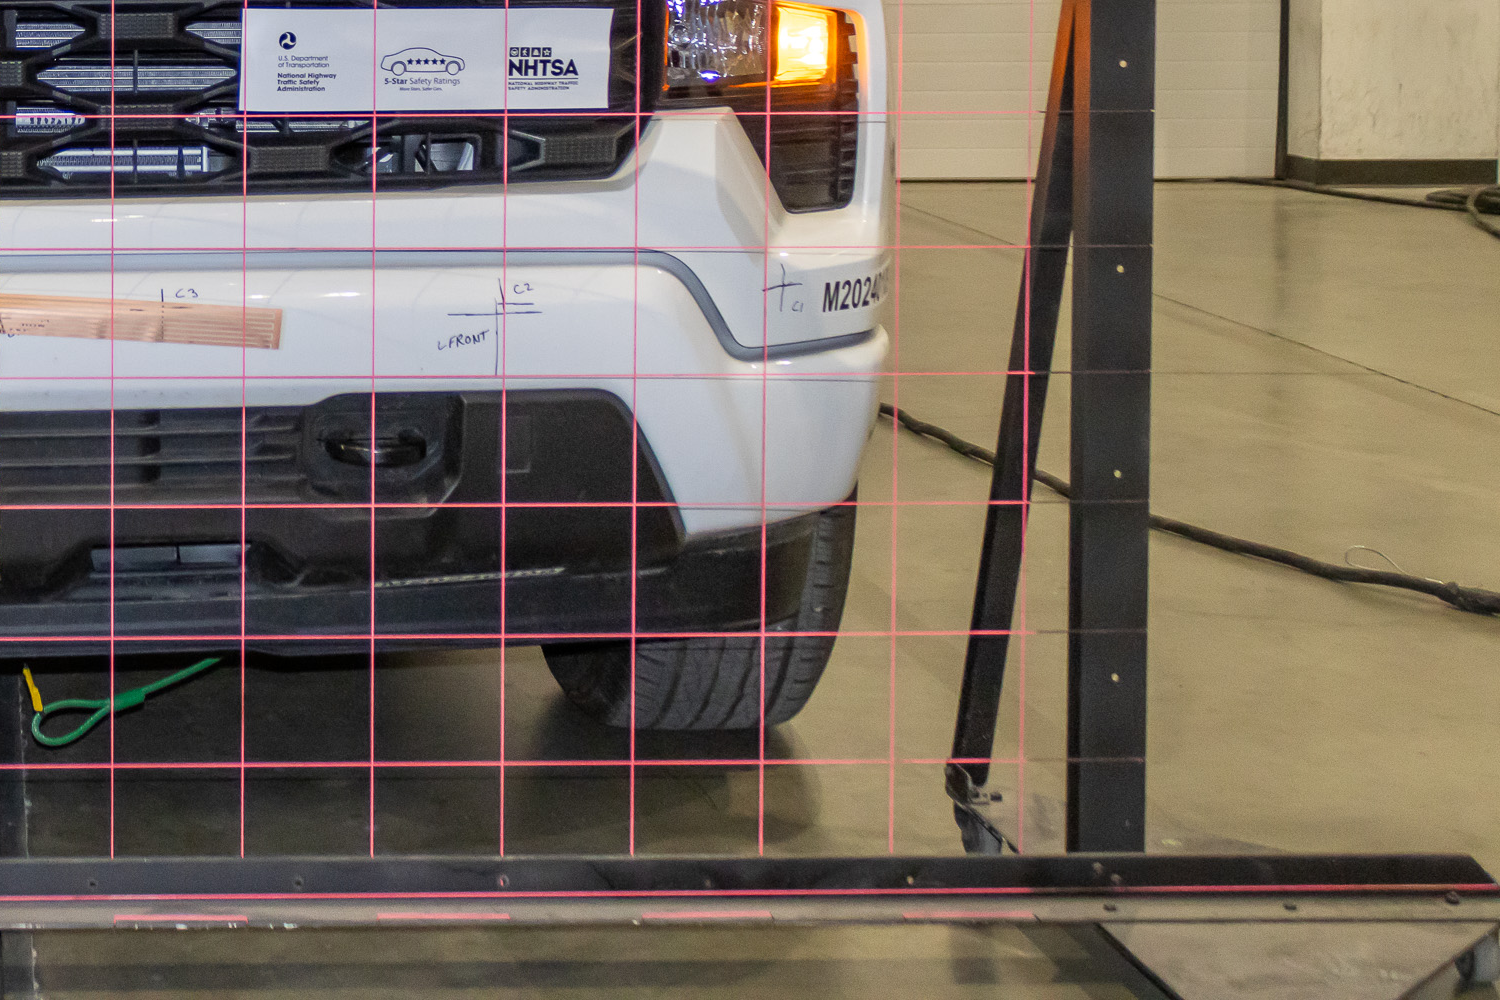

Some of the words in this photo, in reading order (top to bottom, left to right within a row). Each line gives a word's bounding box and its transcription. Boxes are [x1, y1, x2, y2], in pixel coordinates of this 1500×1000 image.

[508, 58, 579, 76] NHTSA
[307, 72, 337, 80] Highway
[384, 77, 408, 85] 5-Star
[409, 77, 432, 86] Safety
[433, 77, 461, 86] Ratings
[175, 288, 199, 299] C3
[513, 282, 534, 295] C2
